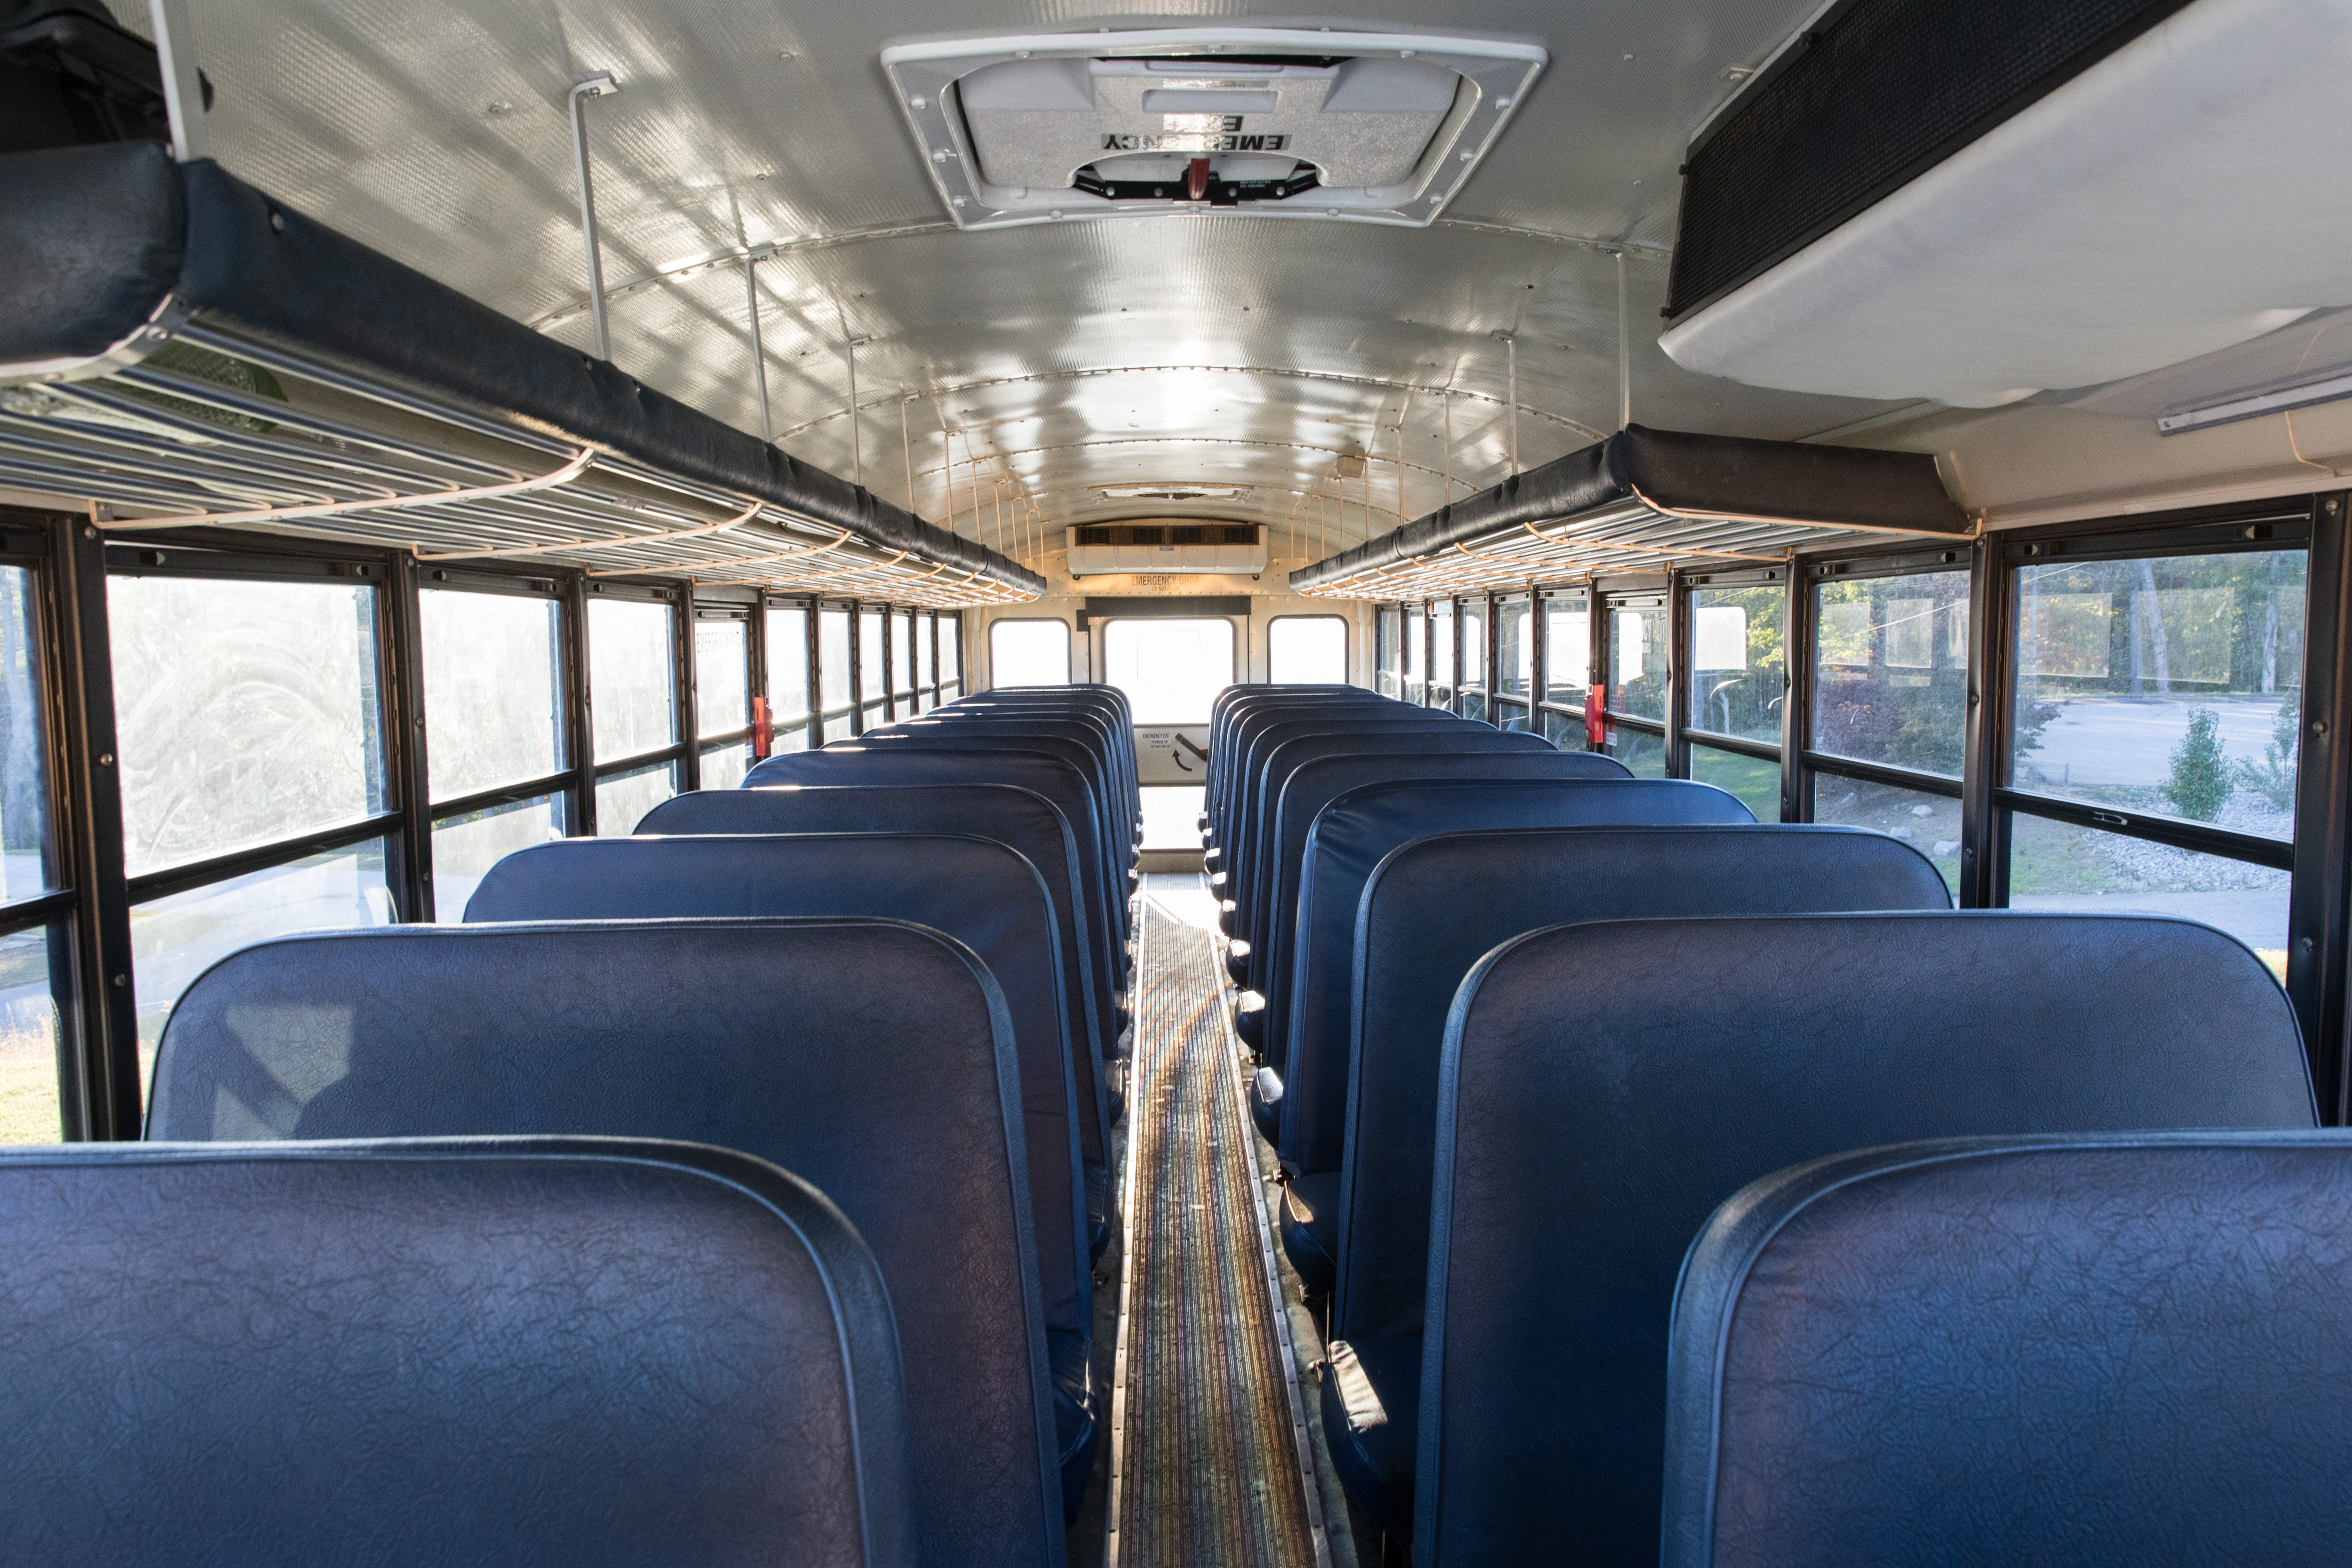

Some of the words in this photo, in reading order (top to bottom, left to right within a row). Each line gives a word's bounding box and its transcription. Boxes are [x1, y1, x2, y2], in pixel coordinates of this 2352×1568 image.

[1104, 135, 1285, 151] EMENCY
[1131, 575, 1176, 586] EMERGENCY
[1179, 575, 1200, 585] DOOR
